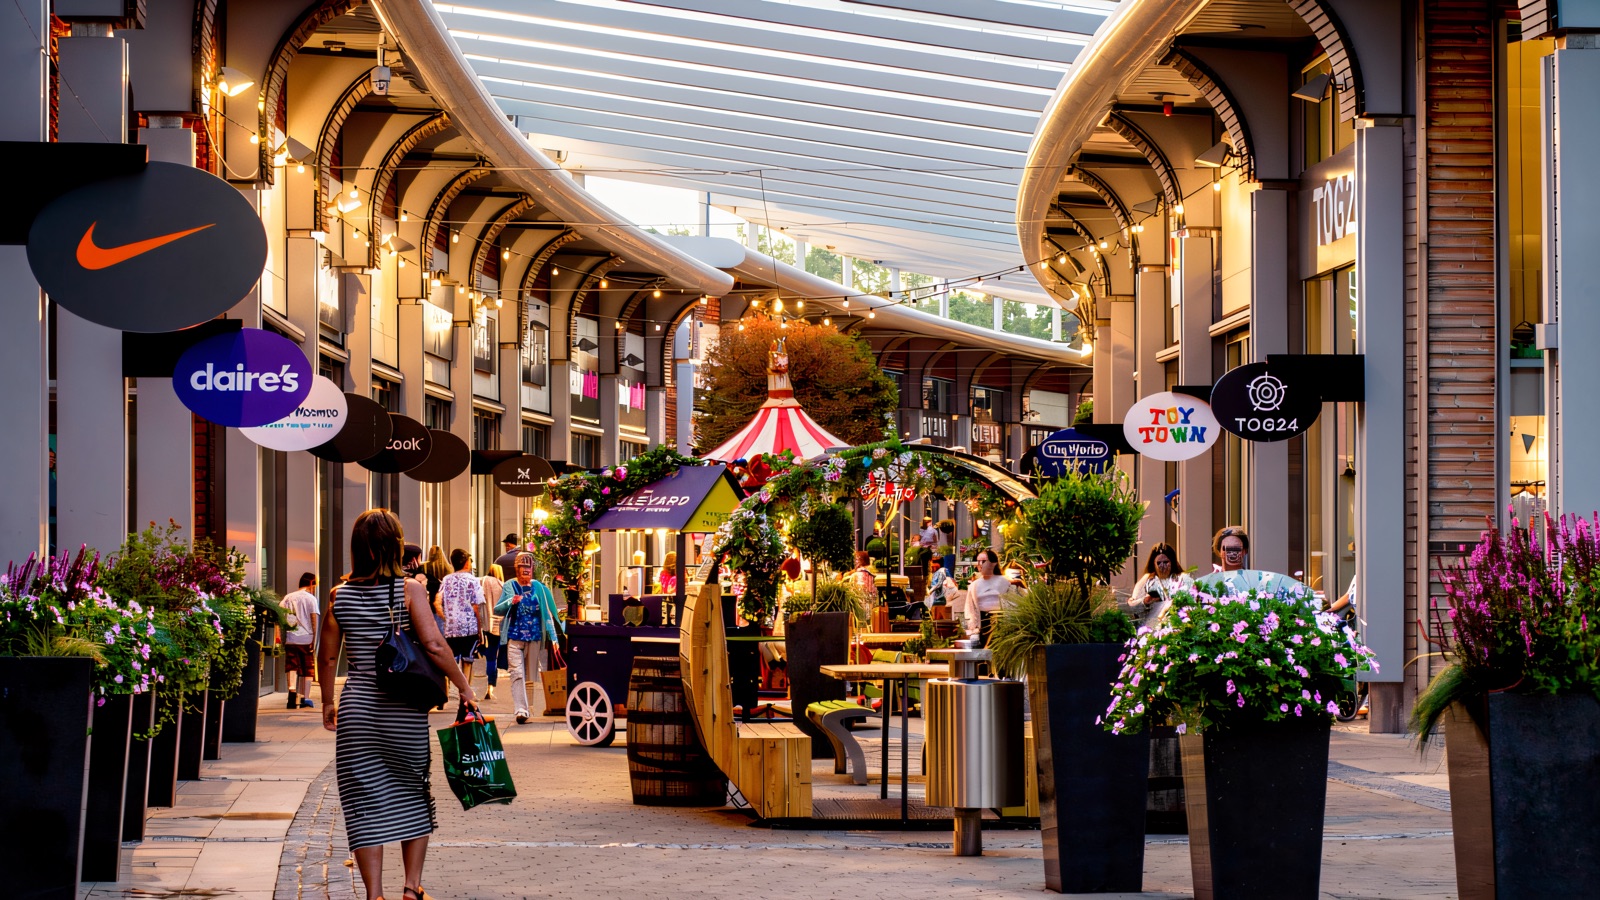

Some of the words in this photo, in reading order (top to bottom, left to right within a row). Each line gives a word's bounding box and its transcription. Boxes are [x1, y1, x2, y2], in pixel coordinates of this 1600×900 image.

[190, 362, 299, 392] claire's
[1150, 407, 1194, 424] TOY
[1235, 417, 1298, 432] TOG24
[1139, 426, 1206, 443] TOWN
